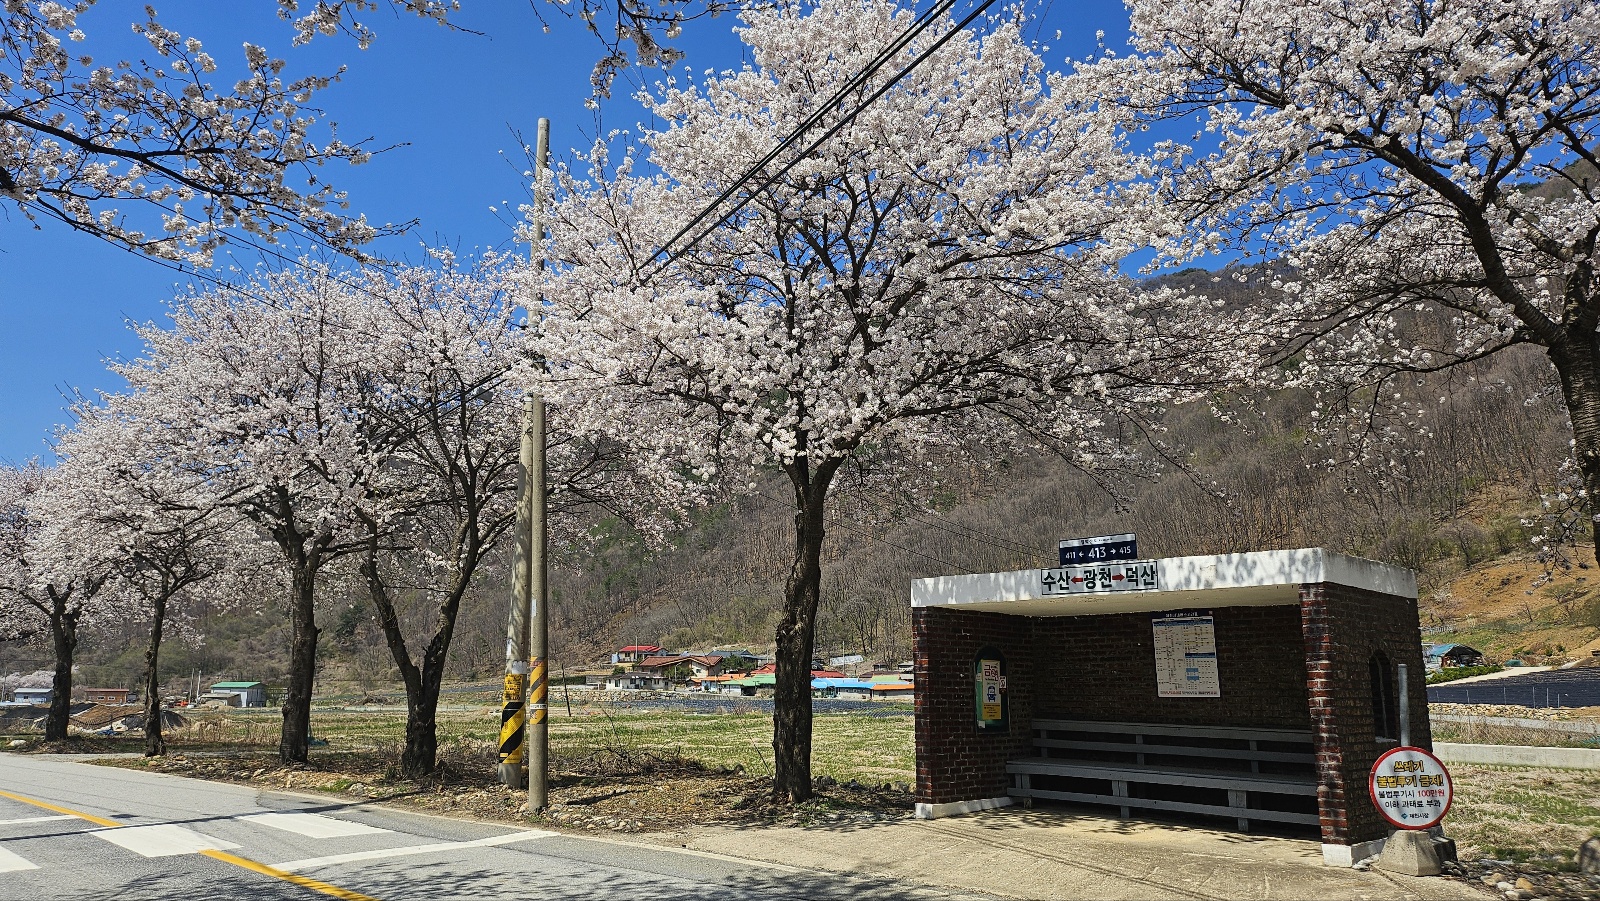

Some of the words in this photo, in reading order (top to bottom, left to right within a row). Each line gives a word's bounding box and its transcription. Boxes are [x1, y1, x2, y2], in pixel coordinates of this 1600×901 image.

[1065, 551, 1076, 559] 411
[1088, 546, 1107, 559] 413
[1119, 545, 1132, 555] 415
[1042, 570, 1071, 592] 수산
[1083, 567, 1113, 590] 광천
[1125, 564, 1156, 587] 덕산
[1394, 760, 1424, 772] 쓰레기
[1377, 775, 1417, 788] 불법투기
[1378, 790, 1415, 798] 불법투기시
[1417, 789, 1445, 798] 100만원
[1385, 800, 1400, 808] 이하
[1402, 800, 1424, 808] 과태료
[1426, 800, 1441, 808] 부과
